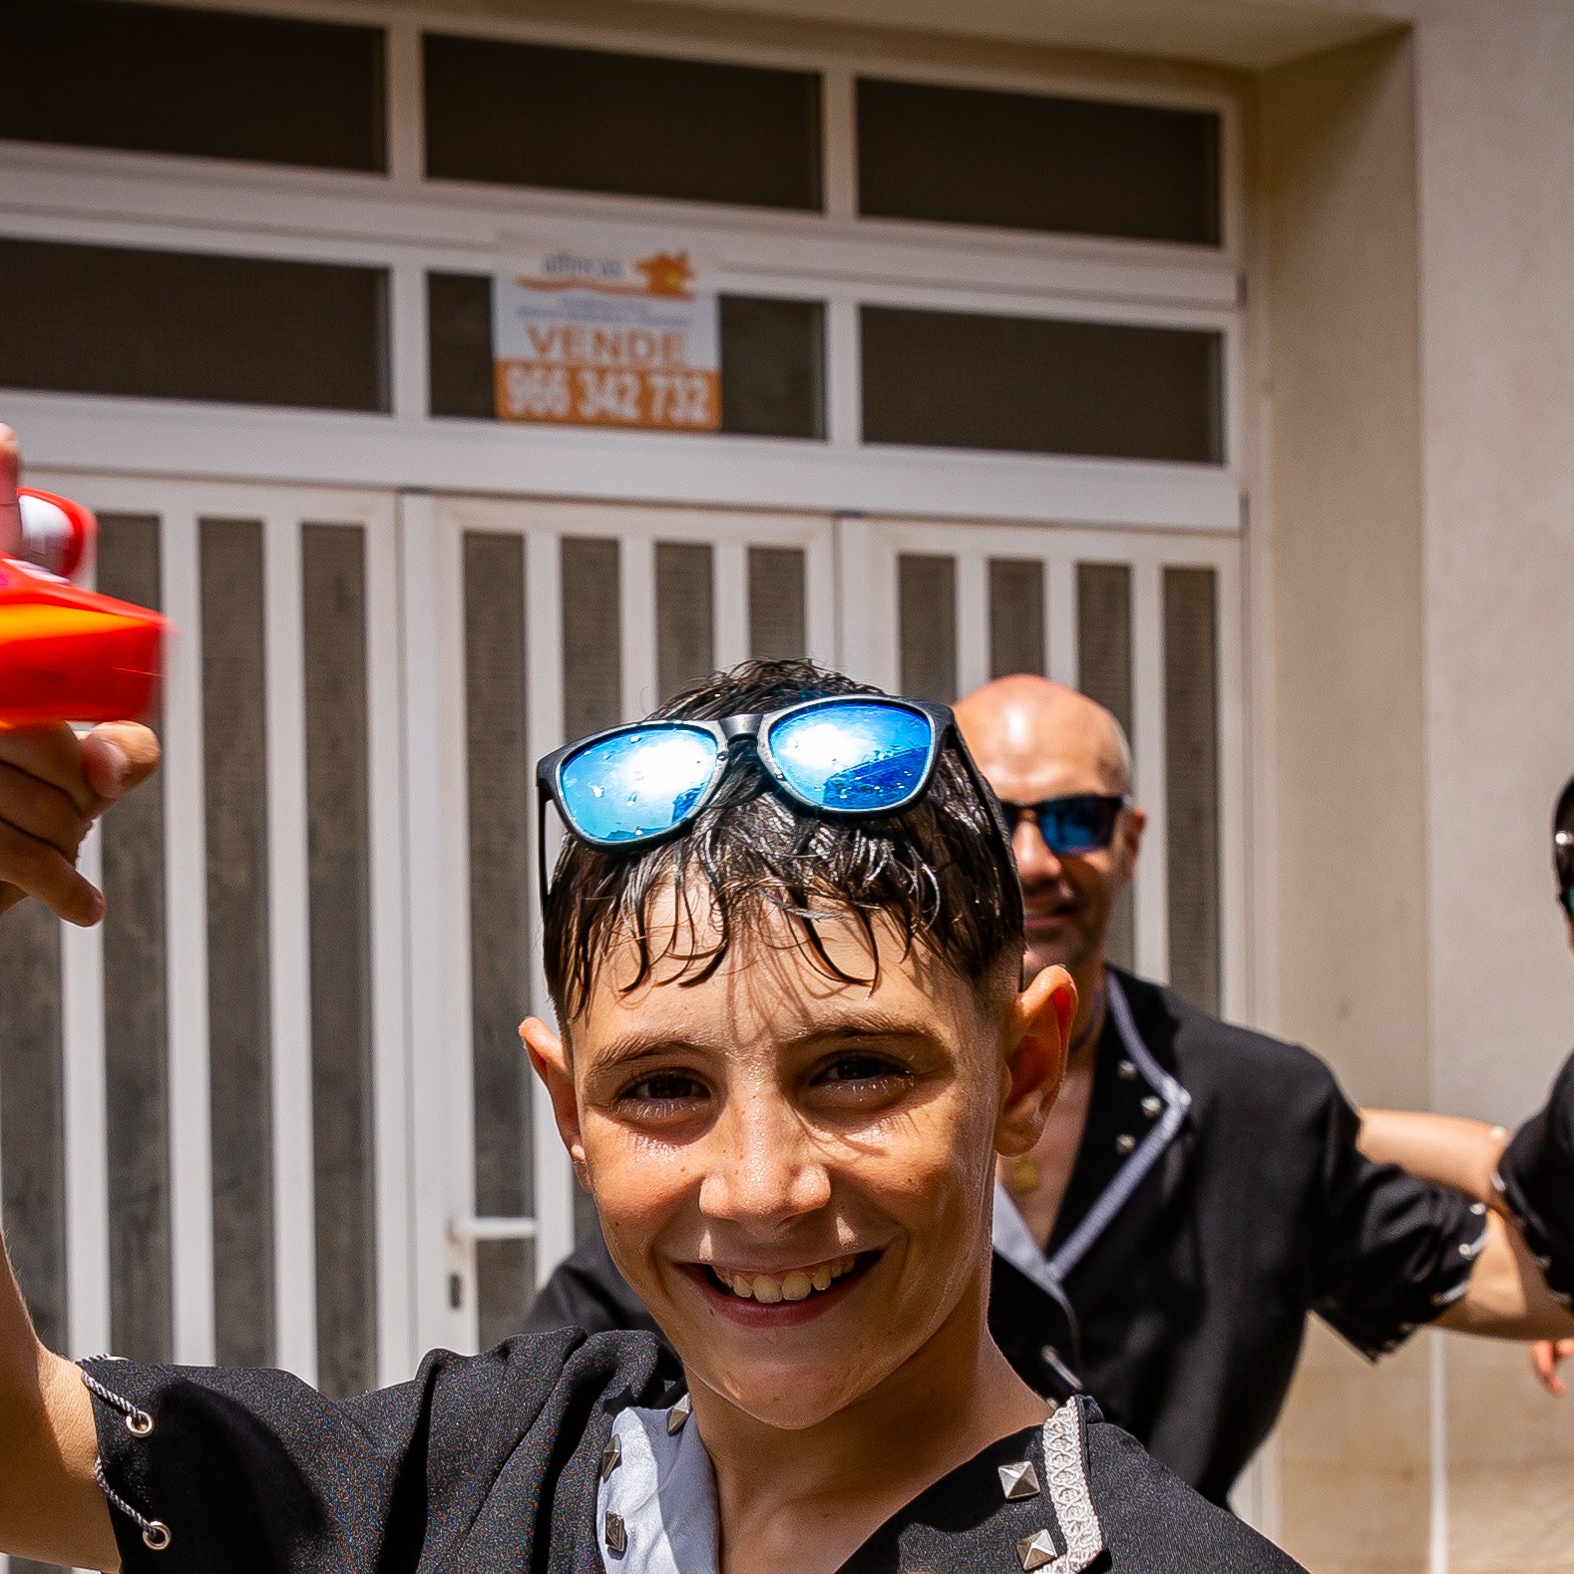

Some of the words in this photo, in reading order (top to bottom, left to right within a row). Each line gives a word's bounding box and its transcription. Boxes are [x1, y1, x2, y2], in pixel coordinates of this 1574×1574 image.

[526, 323, 688, 366] VENDE
[505, 366, 570, 416] 966
[579, 369, 639, 420] 342
